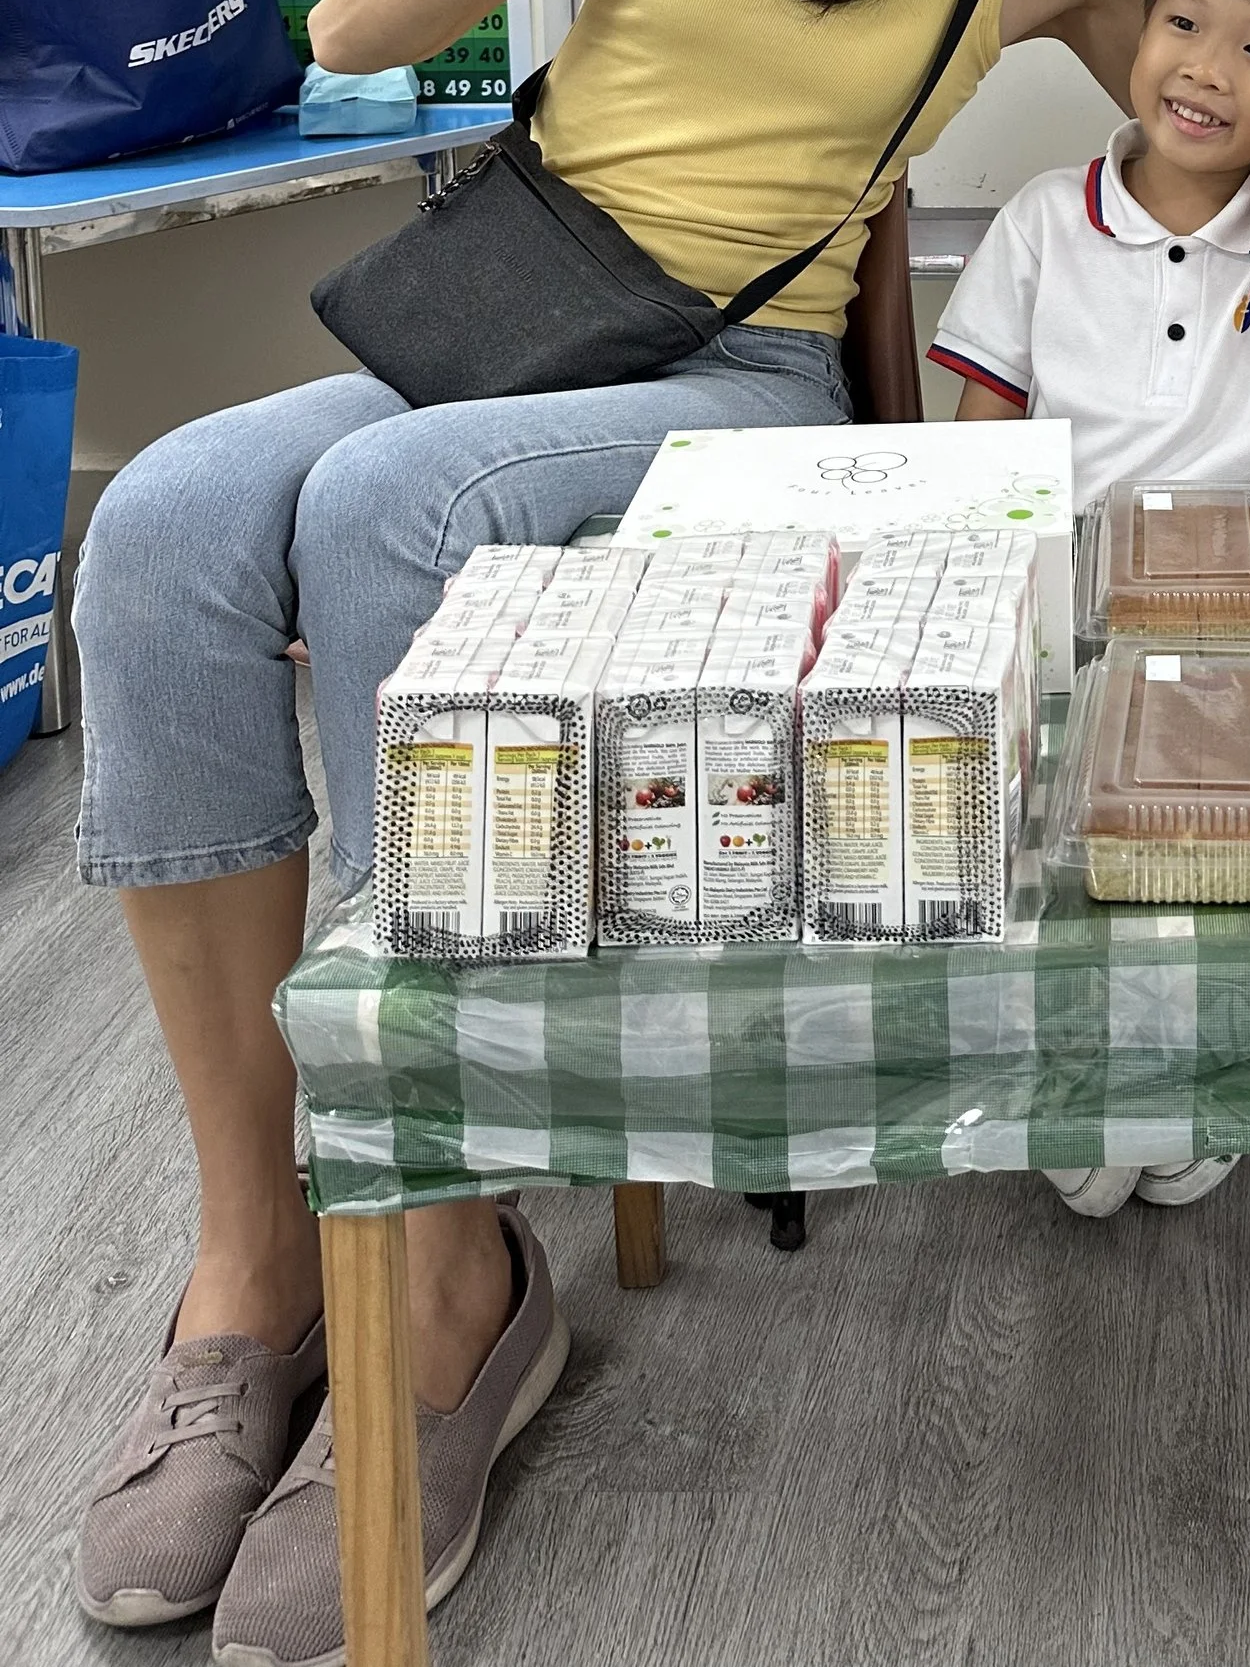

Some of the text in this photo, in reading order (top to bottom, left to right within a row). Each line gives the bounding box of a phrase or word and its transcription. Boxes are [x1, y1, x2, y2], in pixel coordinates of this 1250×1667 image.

[444, 48, 470, 63] 39
[479, 47, 505, 63] 40
[420, 81, 435, 95] 8
[446, 80, 471, 96] 49
[481, 80, 506, 96] 50
[0, 552, 60, 609] CA
[4, 622, 48, 652] FOR AL
[0, 663, 44, 702] www.de
